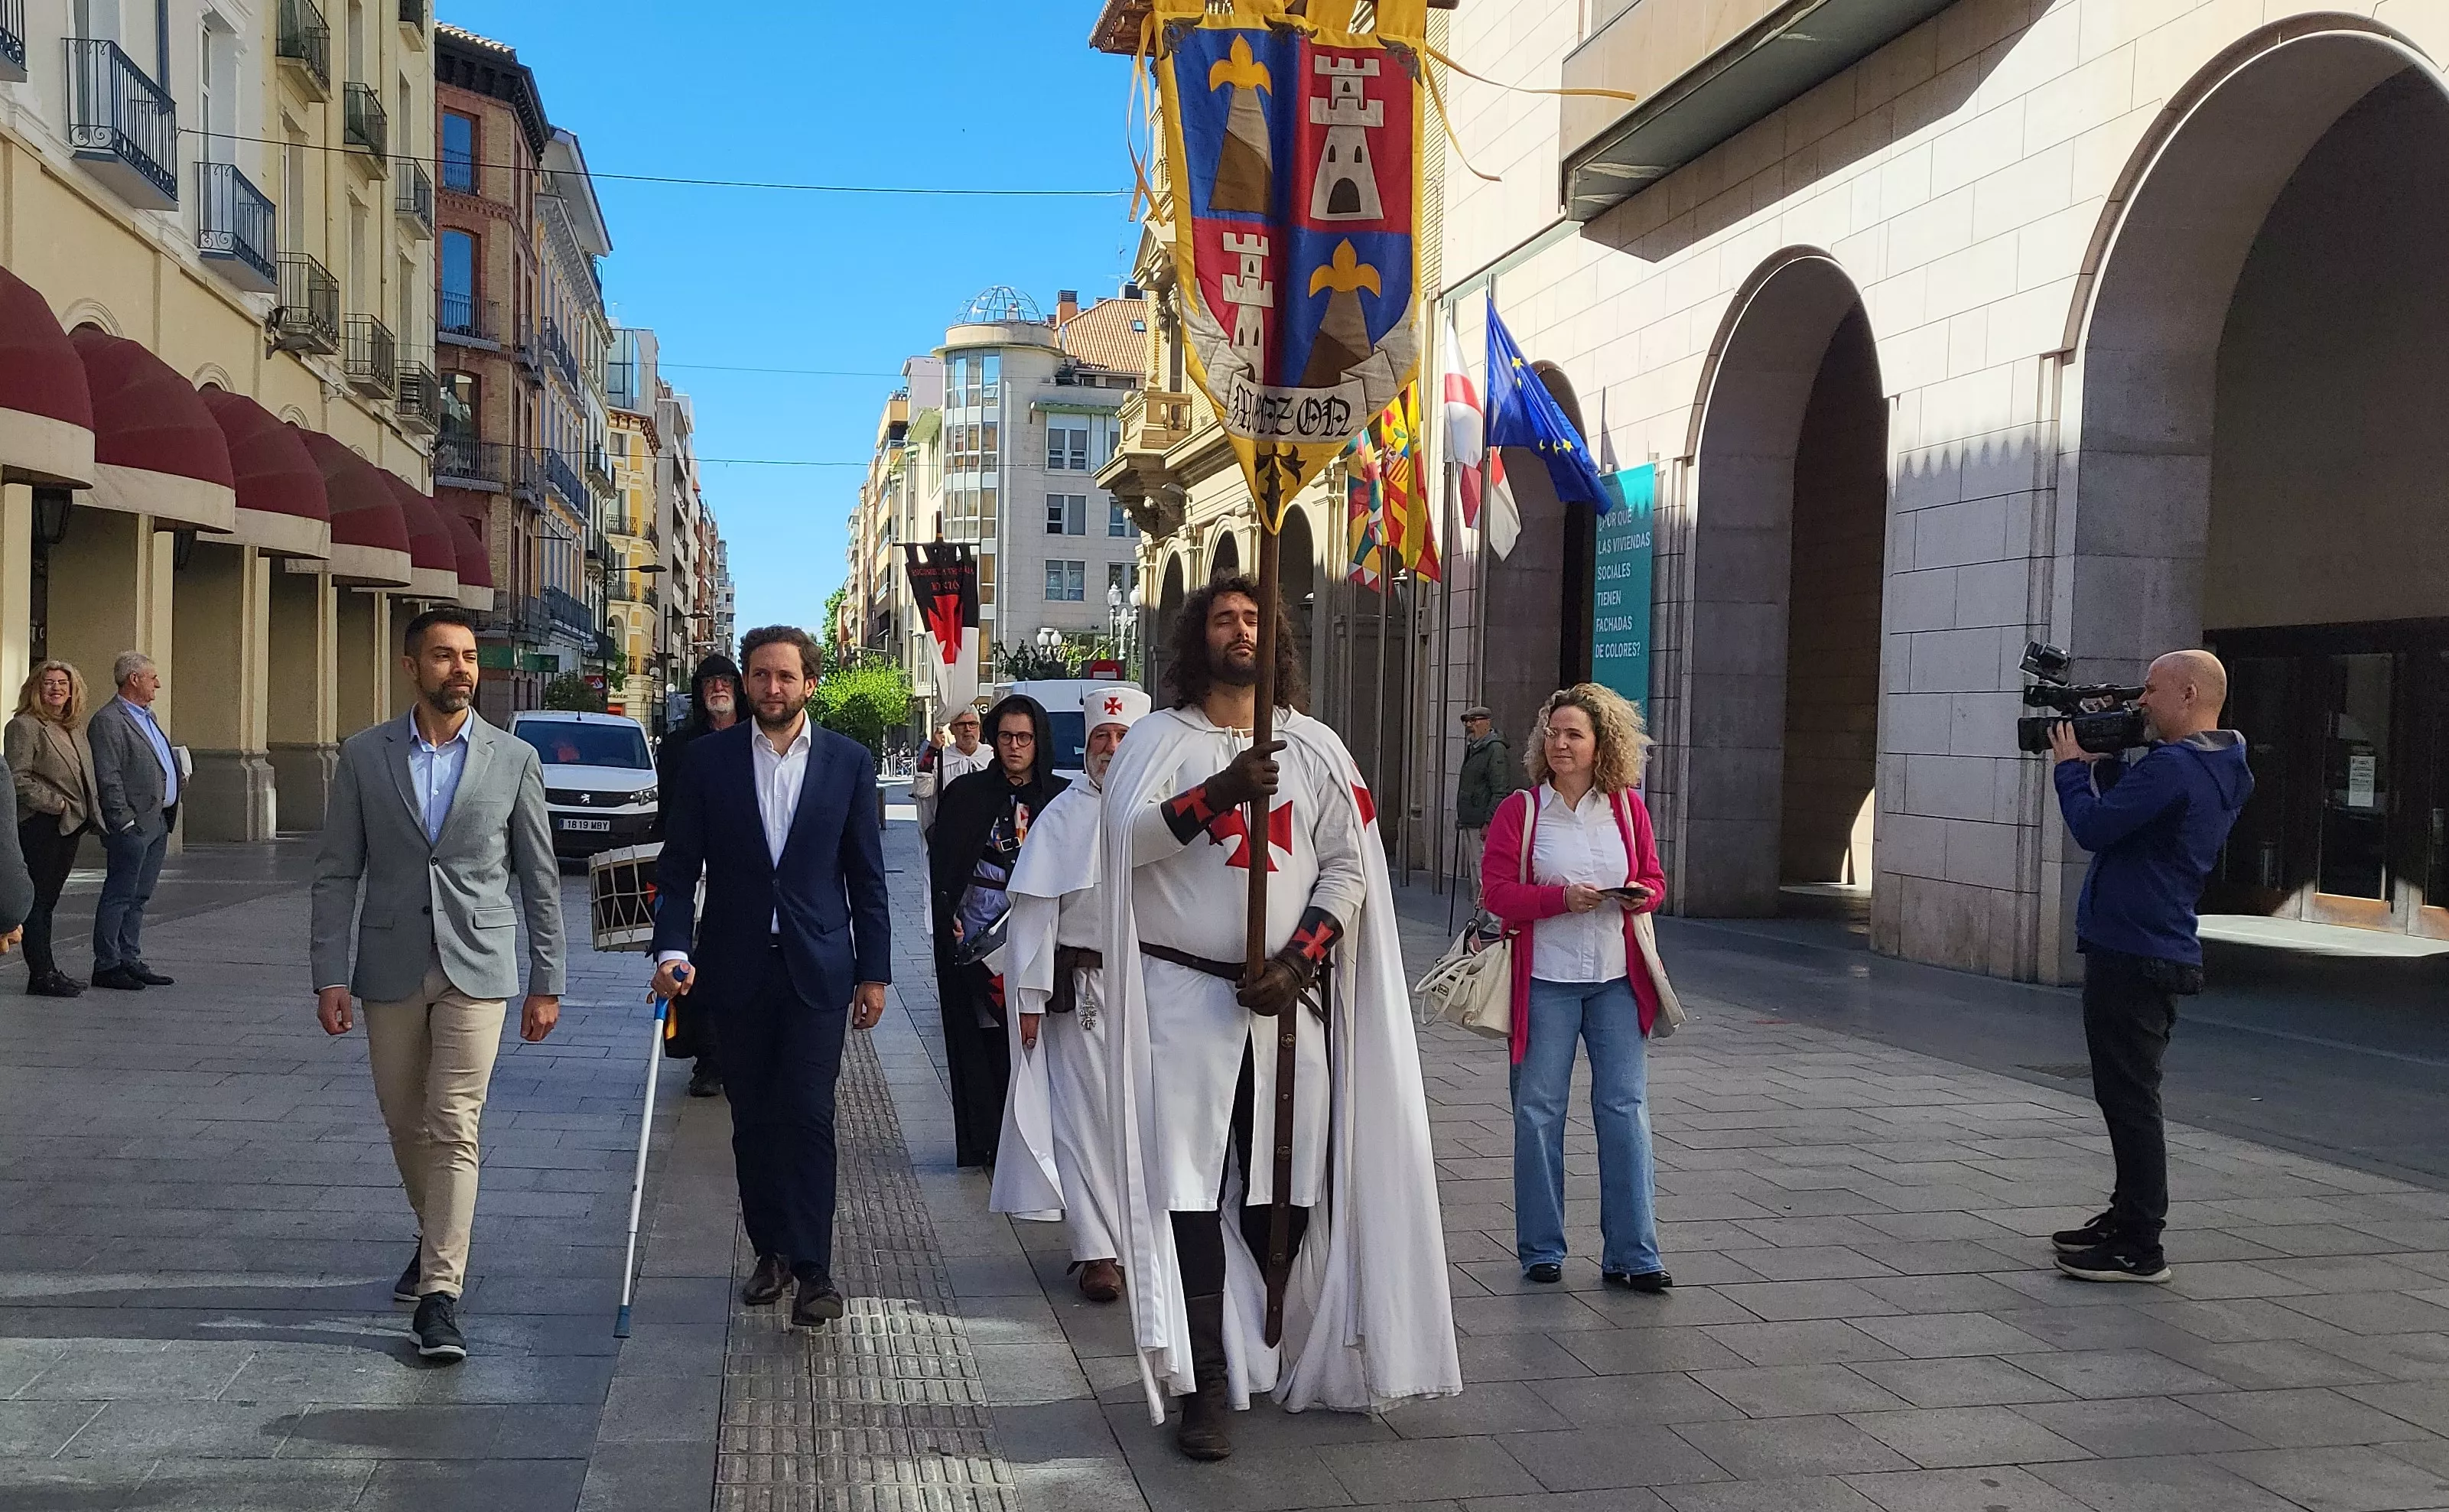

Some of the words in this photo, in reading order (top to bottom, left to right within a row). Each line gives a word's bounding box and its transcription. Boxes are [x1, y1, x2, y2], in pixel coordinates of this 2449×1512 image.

[1618, 505, 1631, 525] QUÉ
[1599, 538, 1611, 554] LAS
[1613, 532, 1651, 552] VIVIENDAS
[1598, 562, 1631, 580] SOCIALES
[1597, 590, 1621, 606] TIENEN
[1595, 615, 1633, 632] FACHADAS
[1595, 644, 1605, 658] DE
[1605, 642, 1641, 658] COLORES?
[590, 821, 608, 831] MBY
